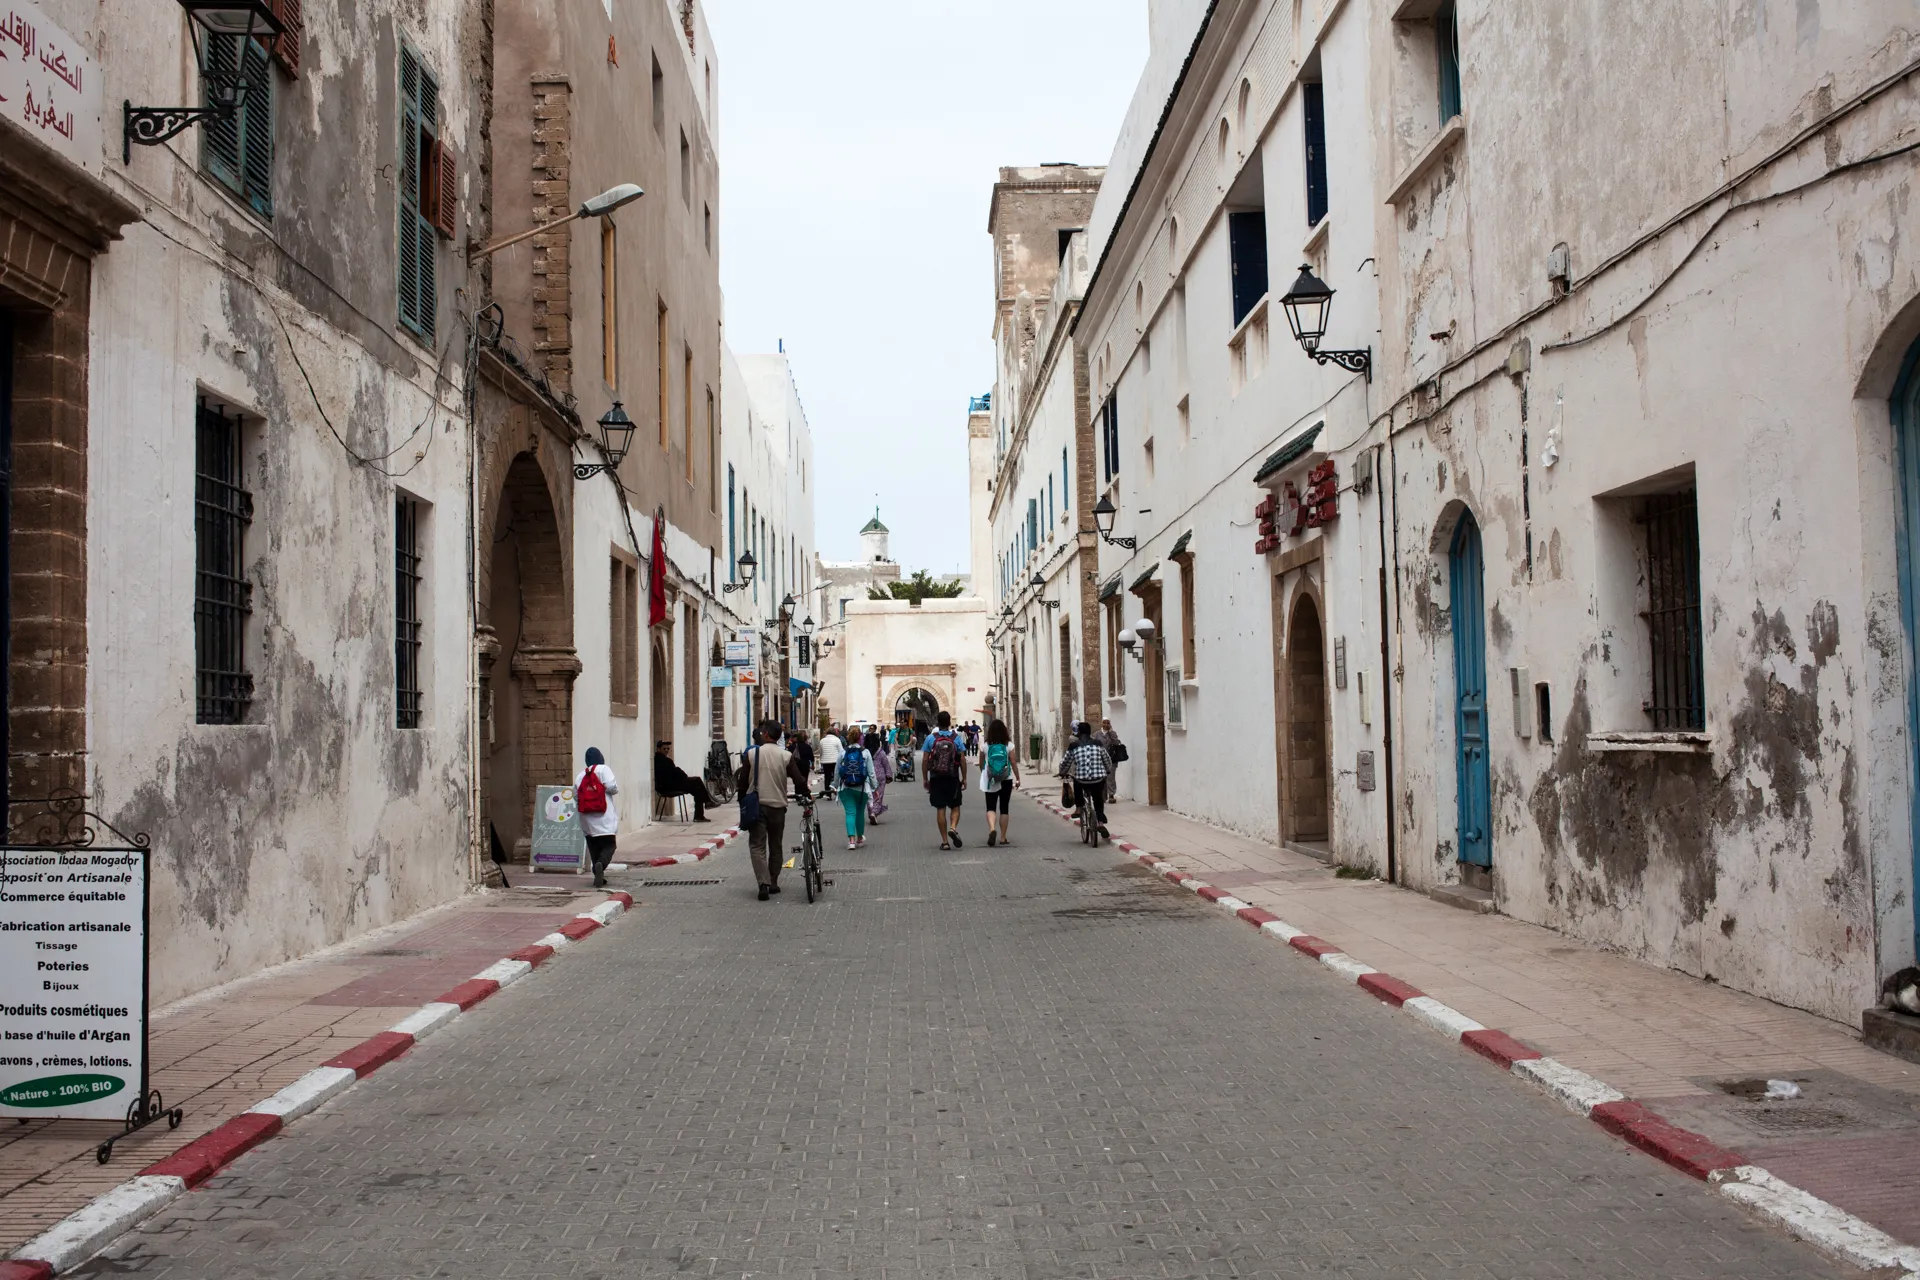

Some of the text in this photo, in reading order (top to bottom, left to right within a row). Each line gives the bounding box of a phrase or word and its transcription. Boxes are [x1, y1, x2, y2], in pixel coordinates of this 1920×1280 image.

[0, 10, 82, 95] المكتب الإقلي
[24, 79, 74, 141] المغربي
[0, 854, 139, 867] ssociation Ibdaa Mogador
[67, 872, 132, 883] Artisanale
[0, 890, 126, 903] Commerce équitable
[68, 921, 132, 932] artisanale
[35, 941, 78, 952] Tissage
[37, 961, 90, 971] Poteries
[43, 980, 79, 992] Bijoux
[50, 1003, 129, 1019] cosmétiques
[5, 1030, 33, 1040] base
[36, 1030, 76, 1040] d'huile
[79, 1029, 131, 1043] d'Argan
[0, 1056, 33, 1066] avons
[42, 1054, 87, 1068] crèmes,
[90, 1055, 132, 1067] lotions.
[10, 1089, 49, 1101] Nature
[59, 1083, 90, 1096] 100%
[92, 1080, 112, 1092] BIO
